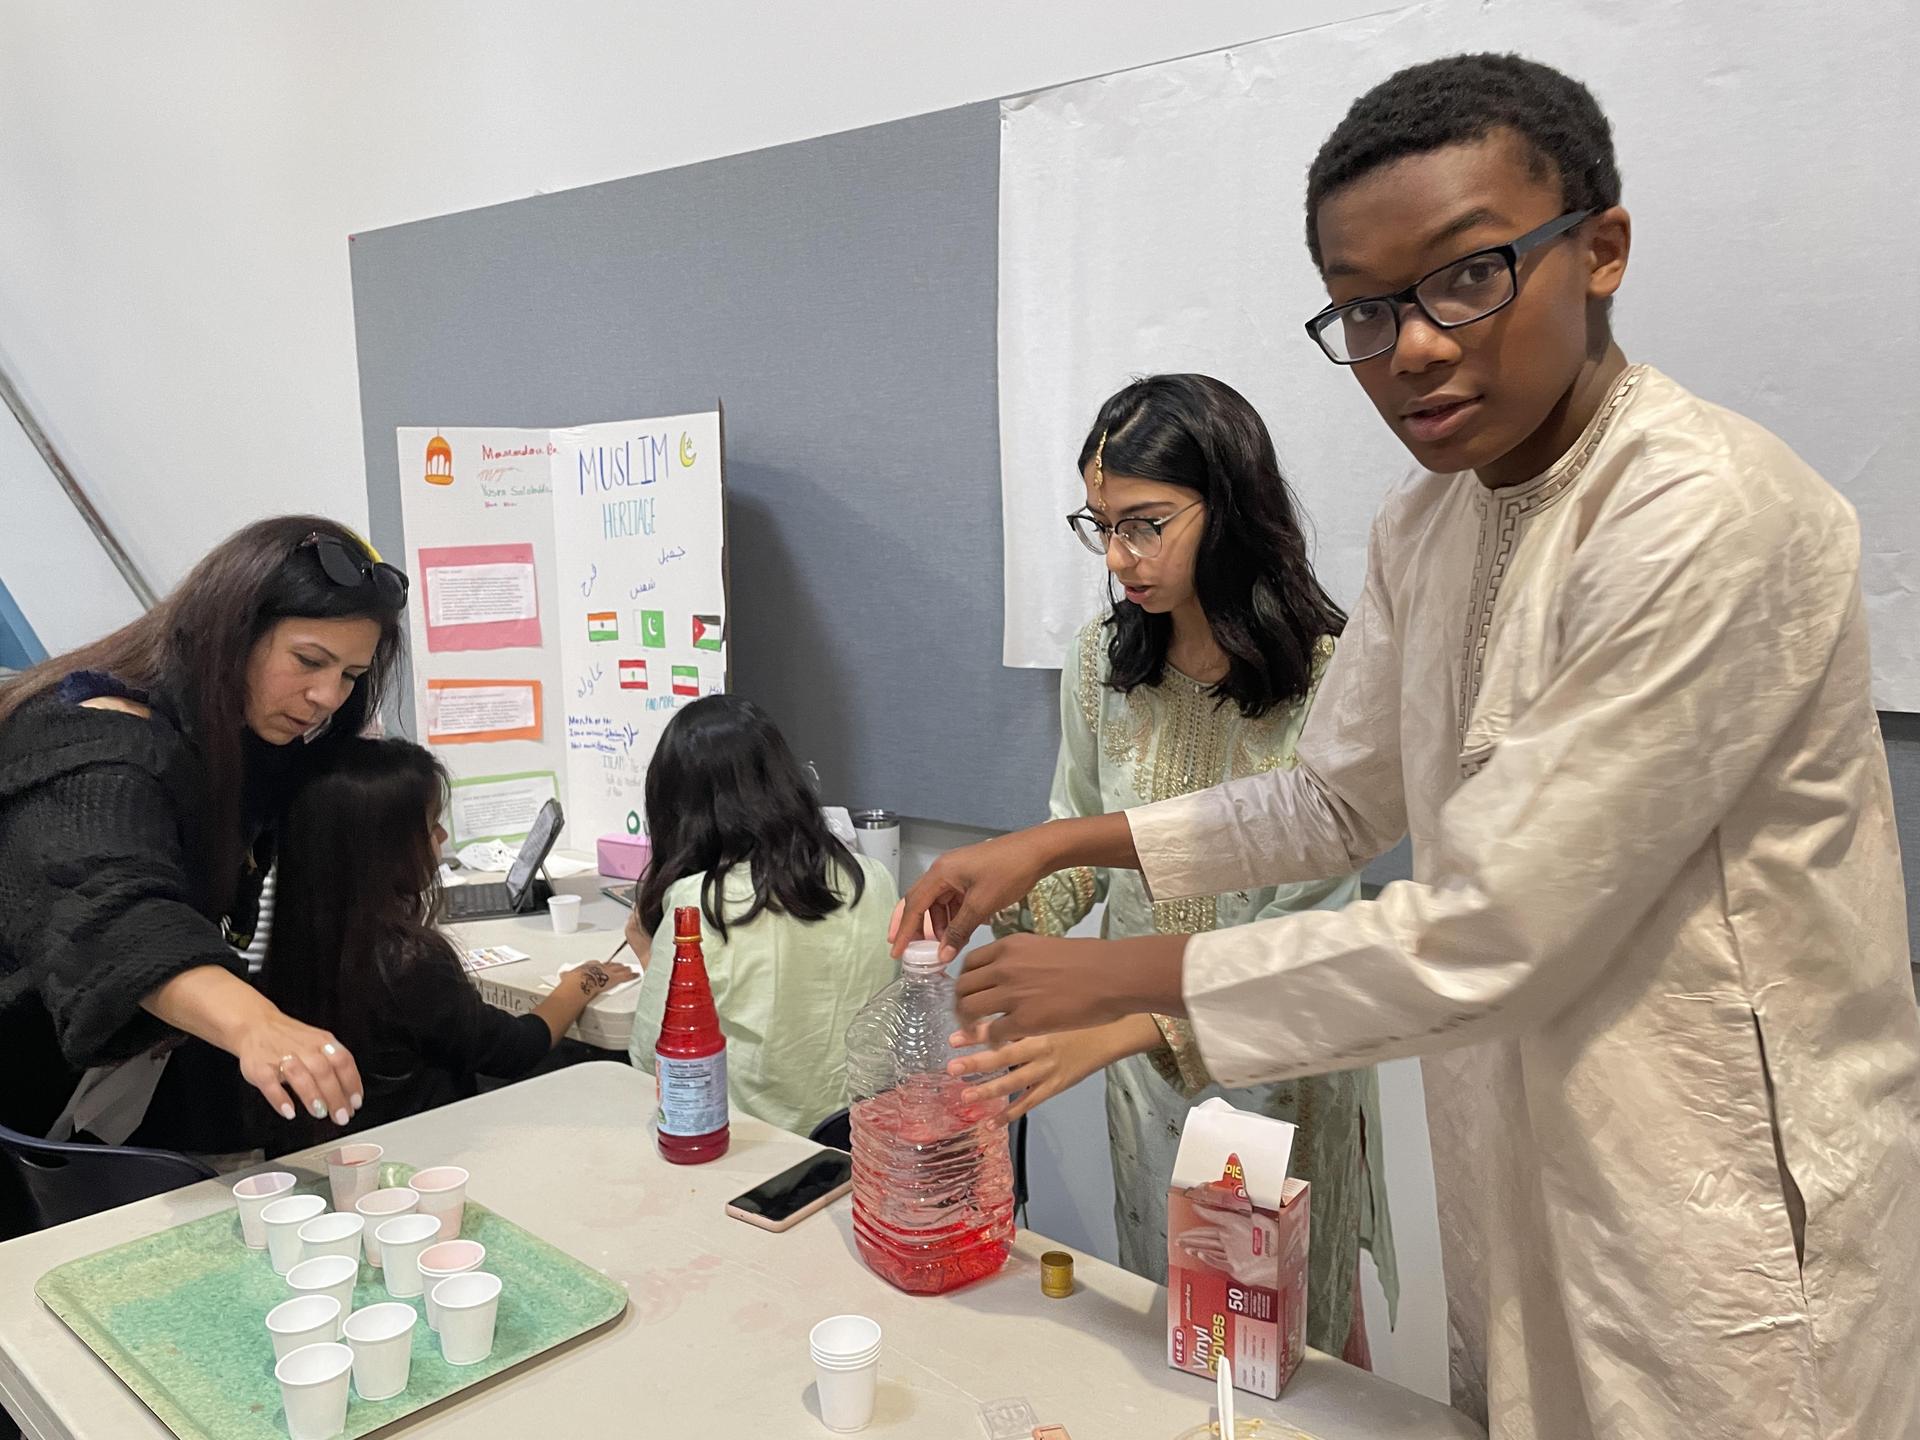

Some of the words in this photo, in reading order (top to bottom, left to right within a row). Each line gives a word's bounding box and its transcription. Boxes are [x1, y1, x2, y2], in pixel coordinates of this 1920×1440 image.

[578, 433, 669, 496] MUSLIM
[602, 498, 656, 541] HERITAGE
[1228, 1288, 1244, 1312] 50
[1192, 1324, 1209, 1370] Vinyl
[1209, 1312, 1226, 1375] Gloves
